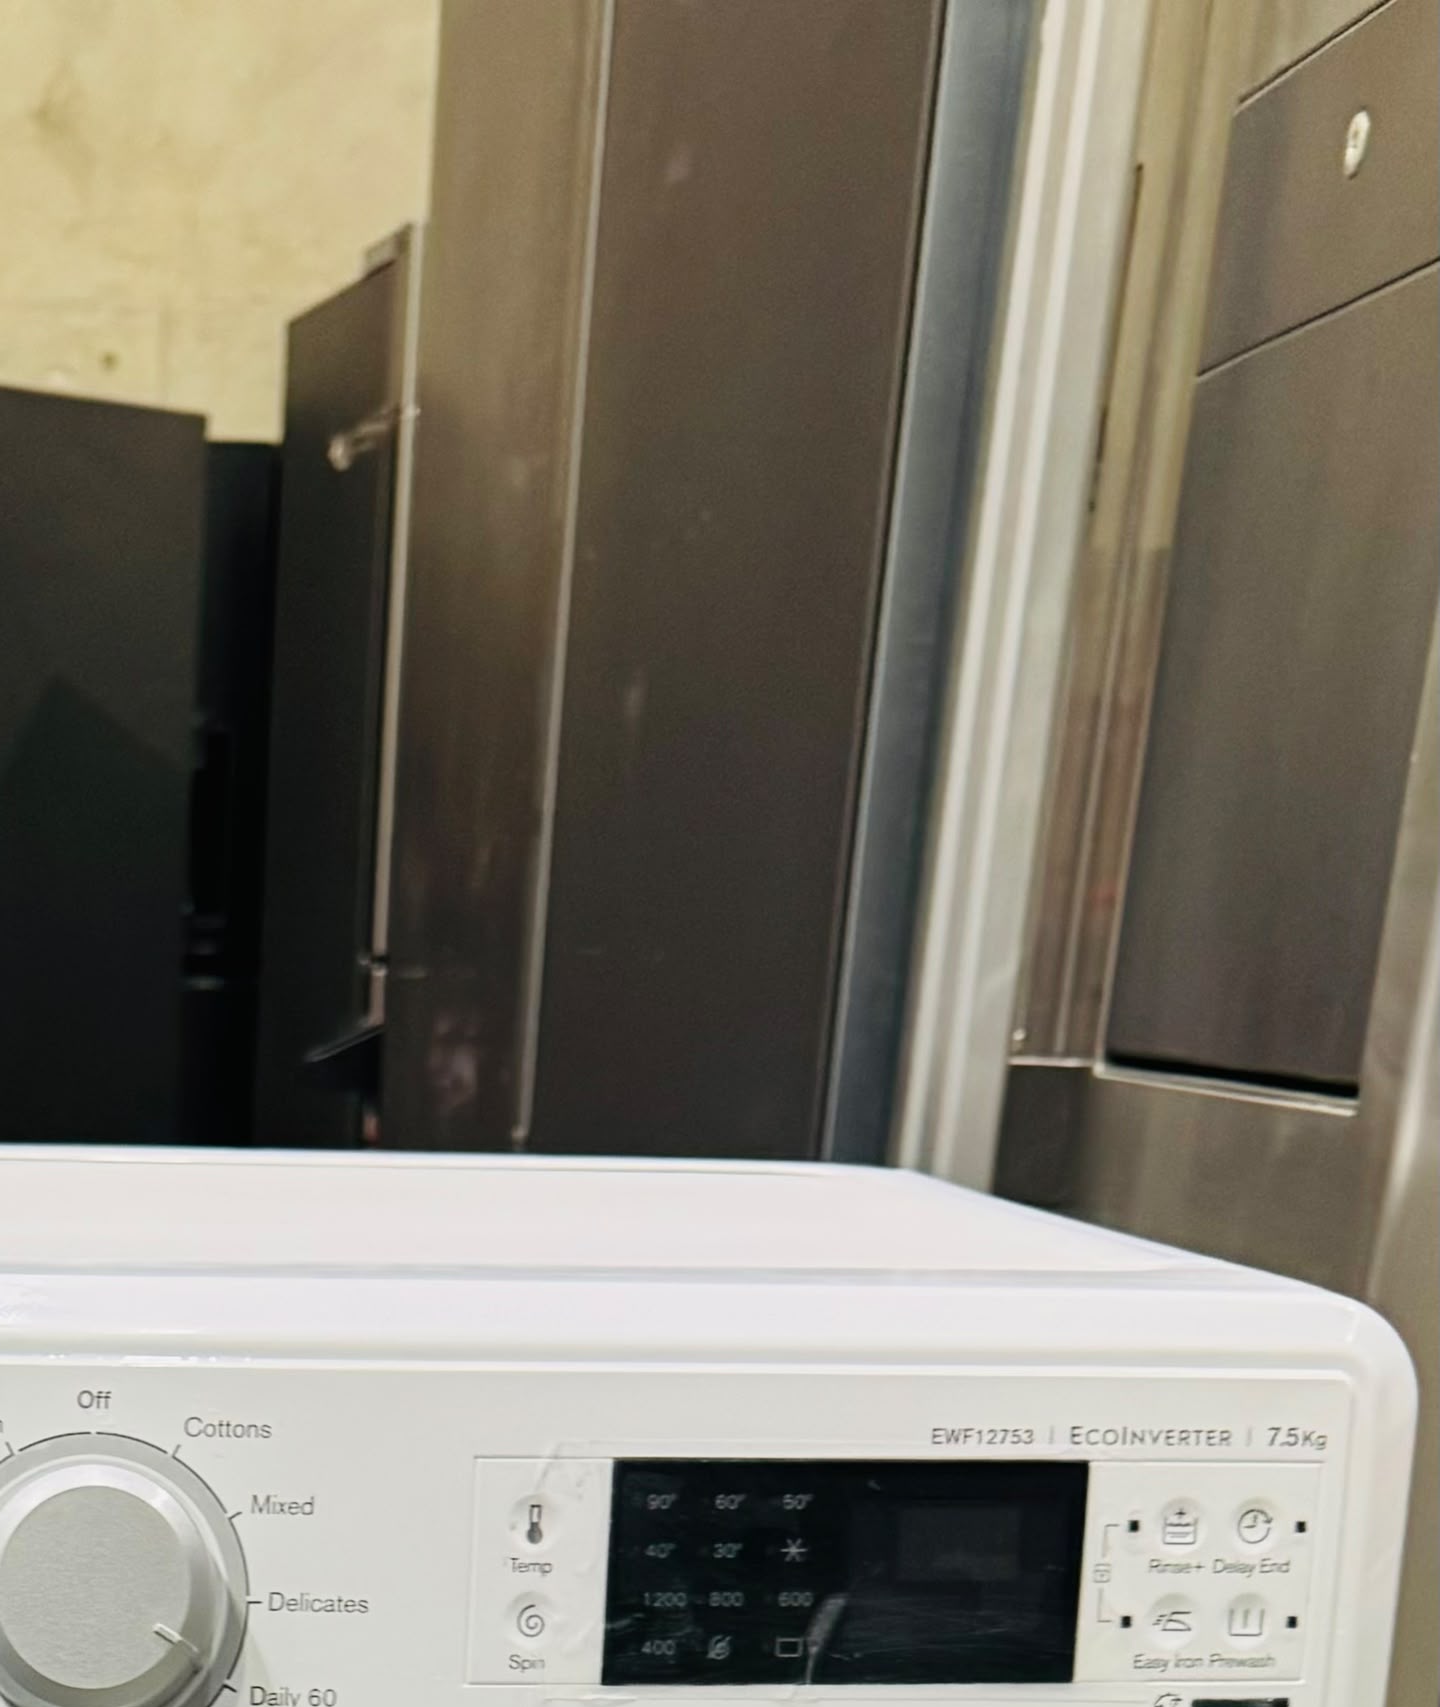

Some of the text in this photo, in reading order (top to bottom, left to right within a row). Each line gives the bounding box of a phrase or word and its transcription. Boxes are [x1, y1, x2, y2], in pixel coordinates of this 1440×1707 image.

[77, 1389, 112, 1409] Off
[183, 1416, 273, 1440] Cottons
[931, 1427, 1035, 1445] EWF12753
[251, 1495, 315, 1517] Mixed
[509, 1556, 553, 1577] Temp
[1260, 1558, 1291, 1574] End
[268, 1592, 370, 1615] Delicates
[508, 1653, 546, 1674] Spin
[307, 1688, 338, 1707] 60
